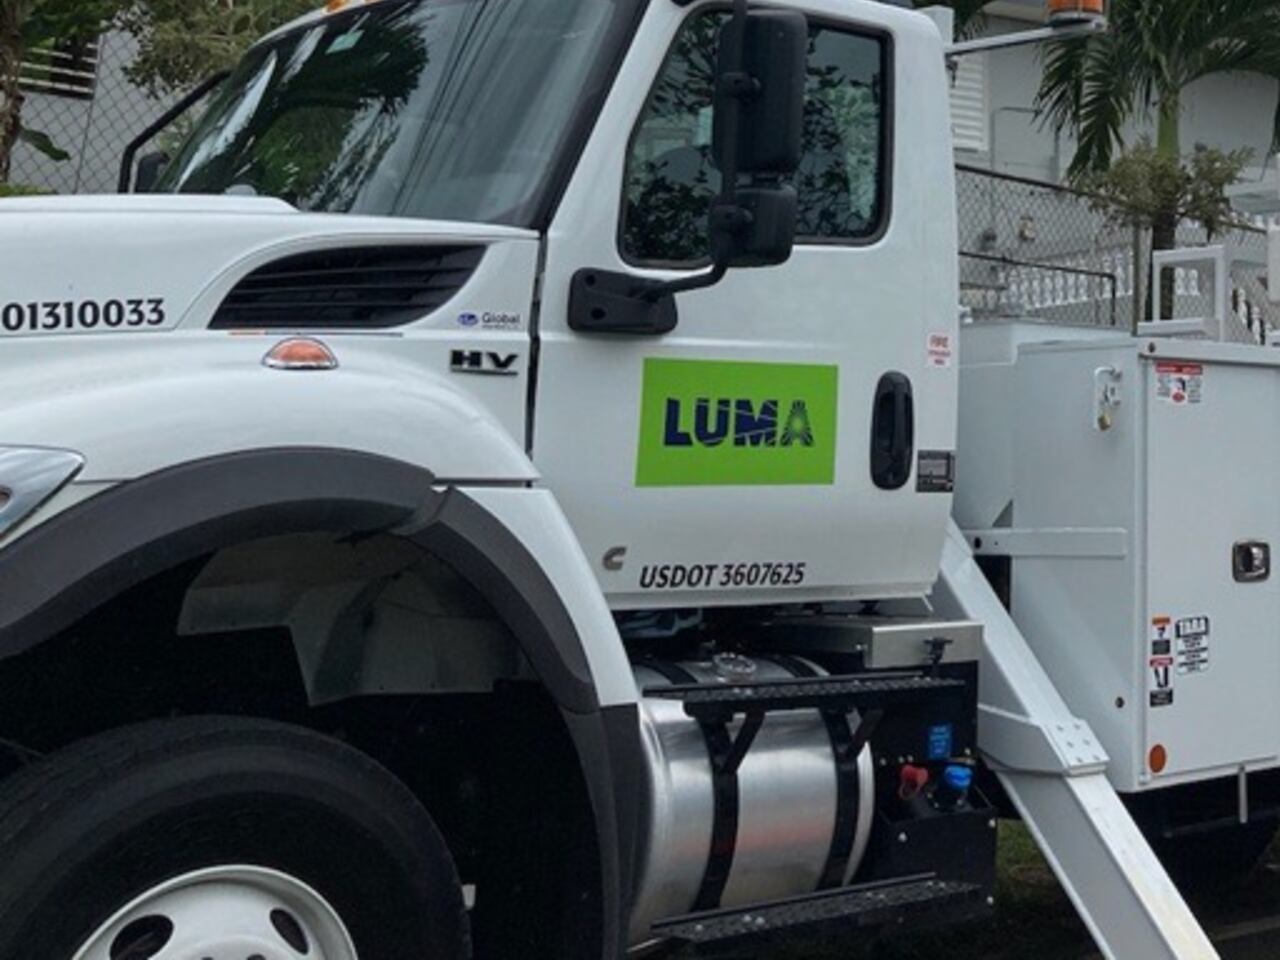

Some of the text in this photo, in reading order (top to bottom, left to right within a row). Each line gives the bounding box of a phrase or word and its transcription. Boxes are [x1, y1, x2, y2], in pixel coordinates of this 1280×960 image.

[2, 298, 165, 331] 01310033
[451, 350, 519, 368] HV
[664, 397, 814, 447] LUMA
[639, 563, 806, 588] USDOT 3607625
